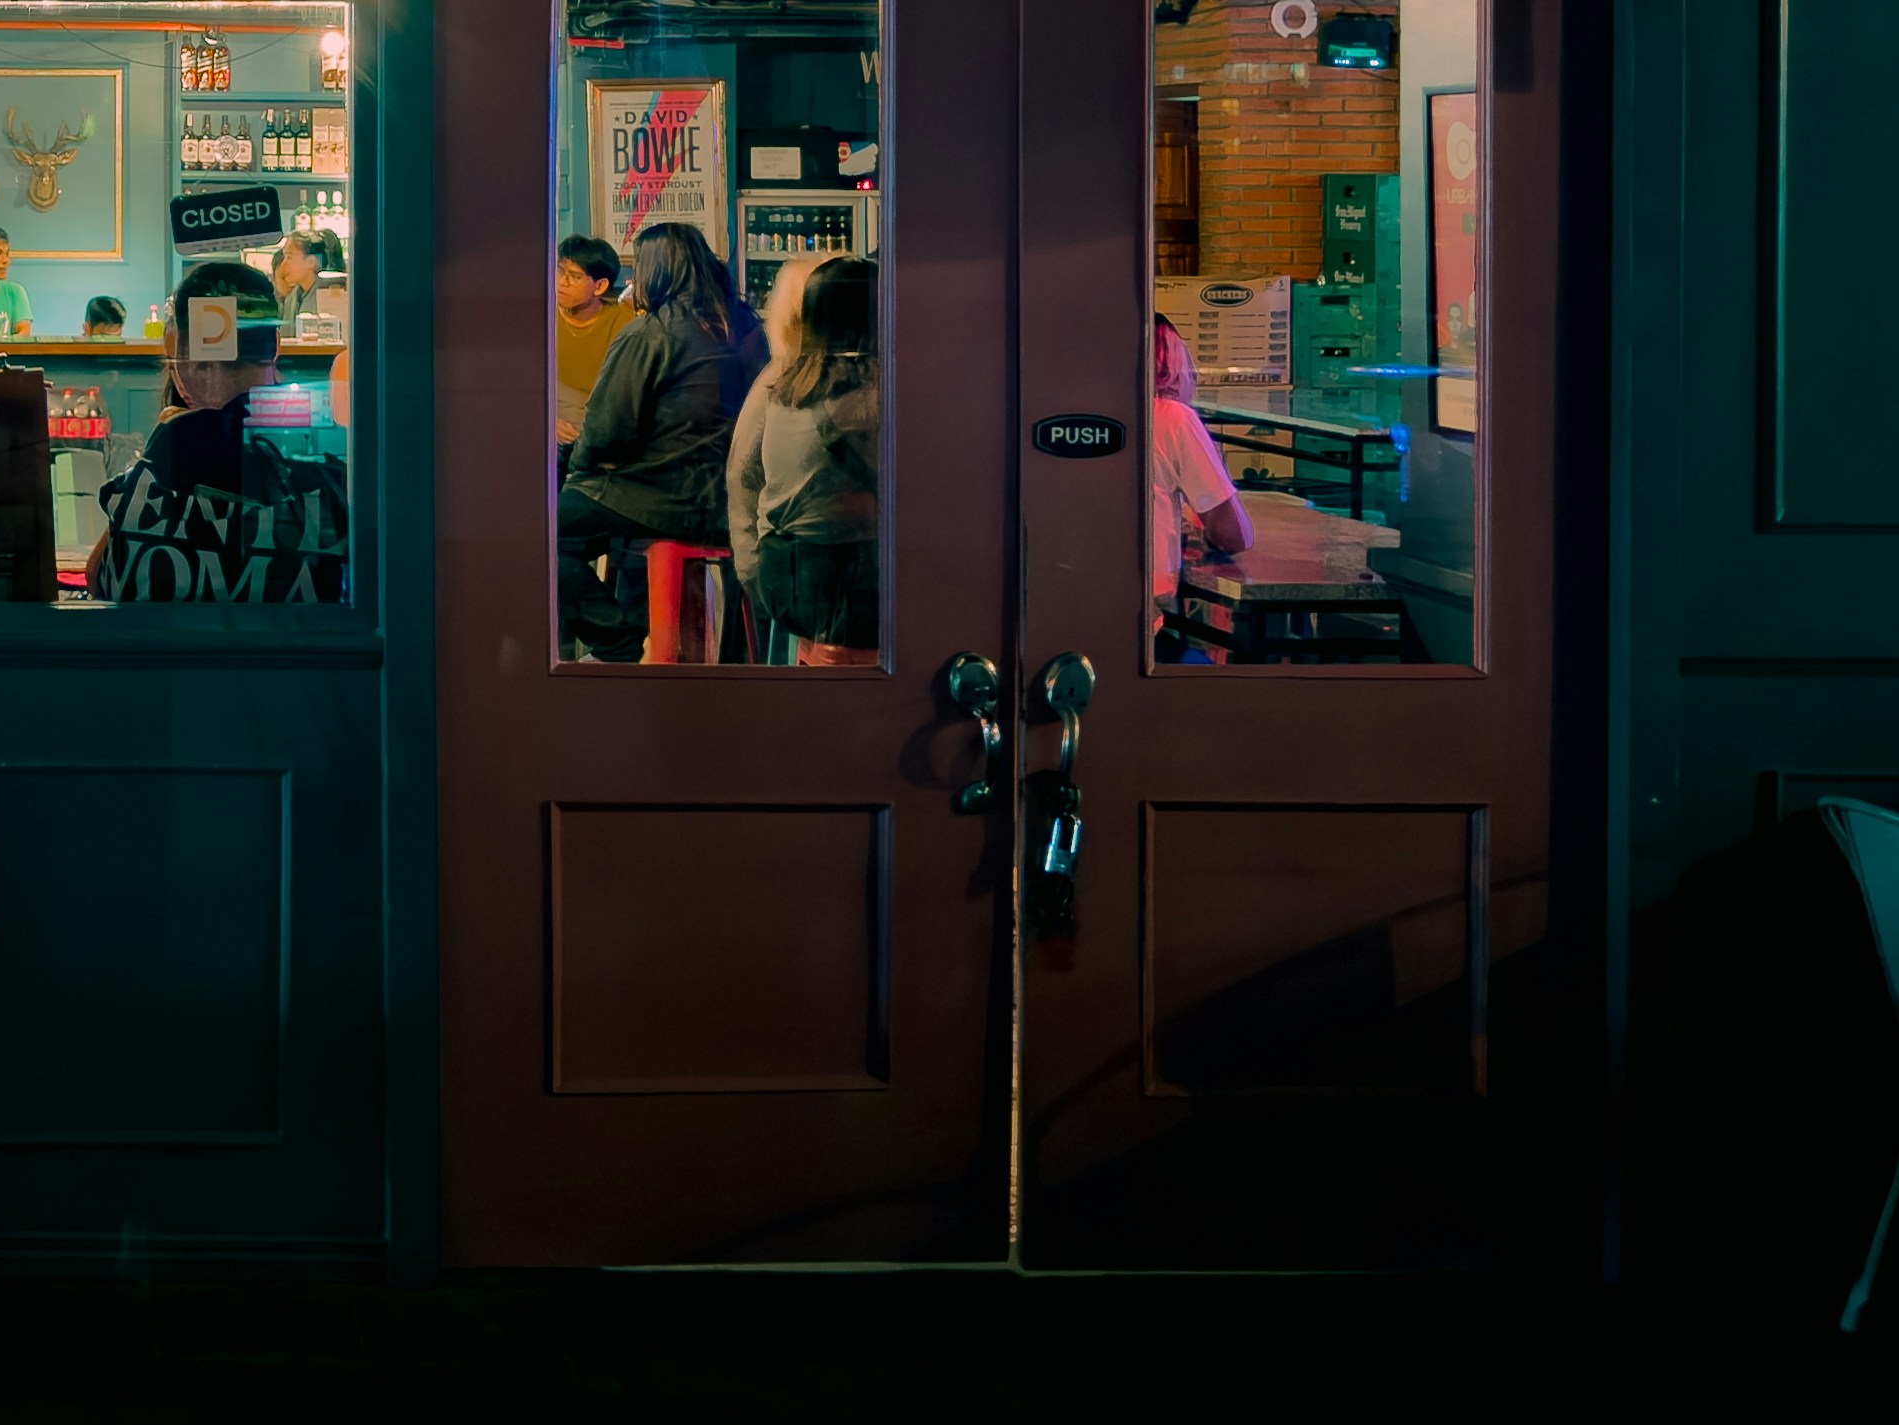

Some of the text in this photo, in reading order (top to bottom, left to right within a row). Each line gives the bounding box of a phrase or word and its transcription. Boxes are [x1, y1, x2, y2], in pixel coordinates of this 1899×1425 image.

[624, 110, 688, 125] DAVID
[613, 126, 702, 174] BOWIE
[647, 180, 702, 189] STARDUST
[678, 192, 705, 211] ODEON
[181, 201, 271, 228] CLOSED
[1051, 426, 1109, 444] PUSH
